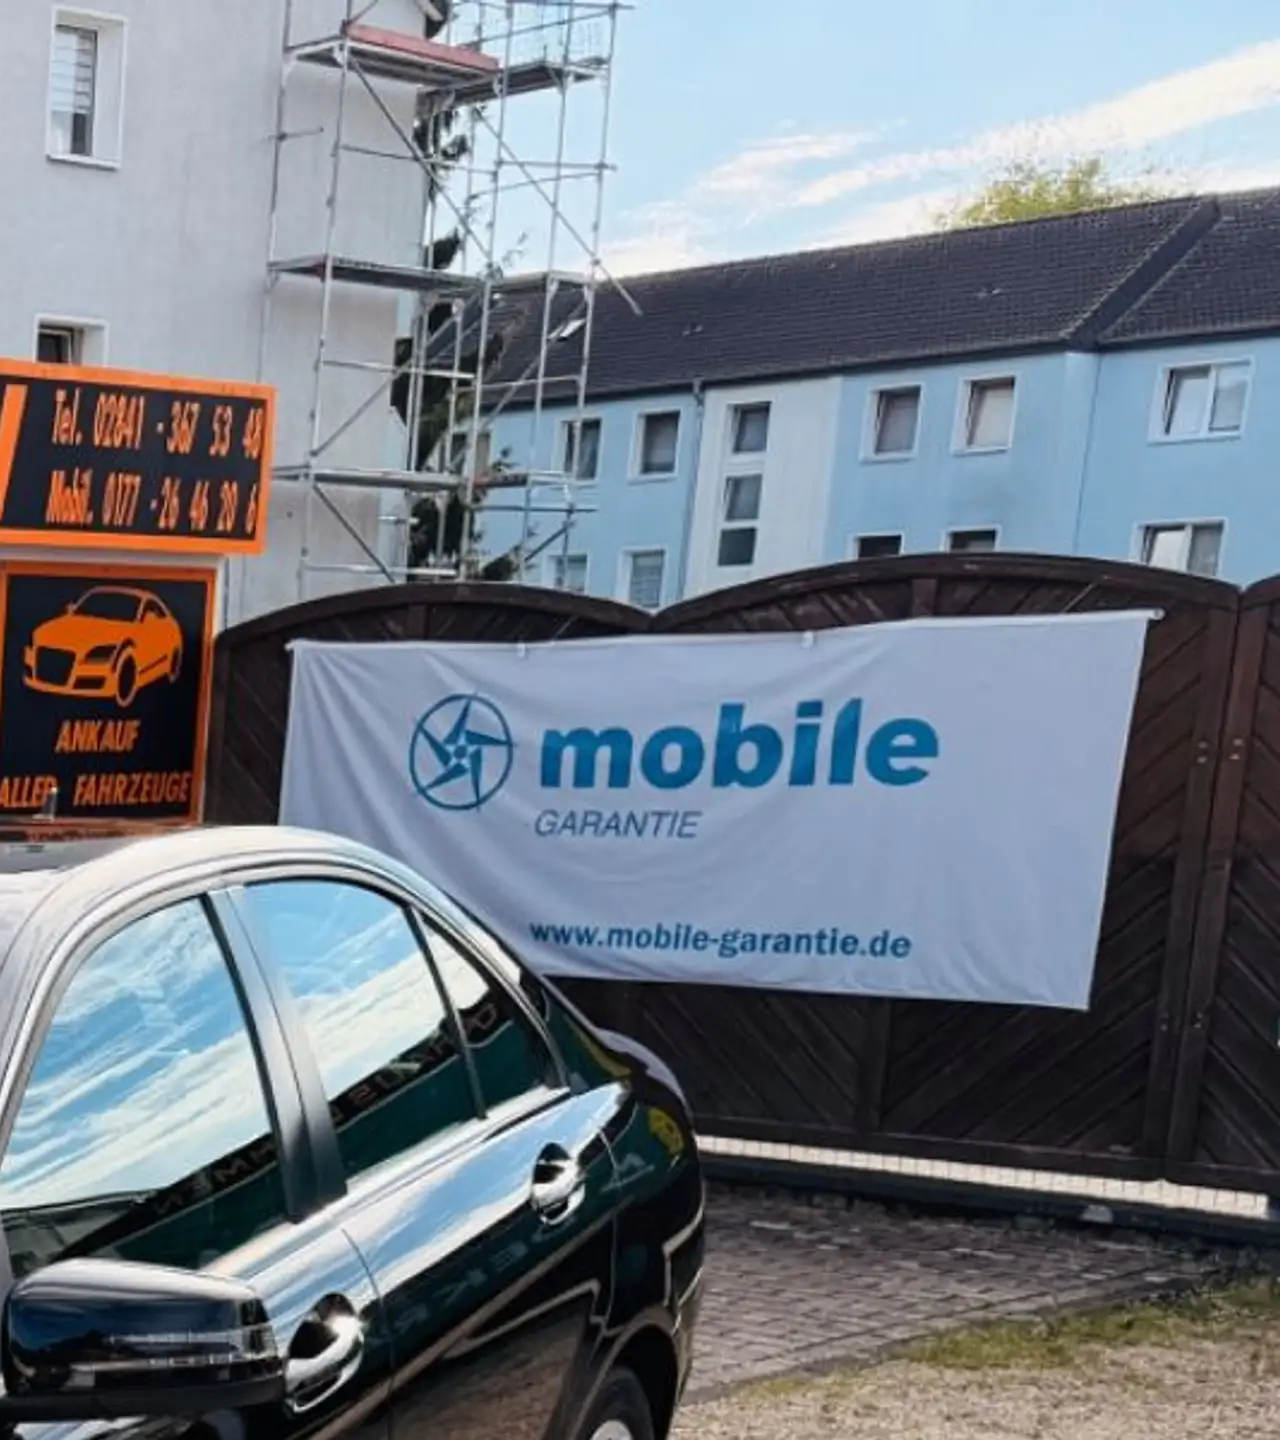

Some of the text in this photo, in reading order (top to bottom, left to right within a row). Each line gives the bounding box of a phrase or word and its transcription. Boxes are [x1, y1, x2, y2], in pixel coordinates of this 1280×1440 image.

[52, 387, 82, 445] Tel.
[93, 393, 145, 449] 02841
[209, 405, 233, 457] 53
[243, 408, 263, 459] 48
[46, 467, 94, 525] Mobil.
[102, 472, 141, 527] 0177
[190, 480, 210, 531] 46
[215, 480, 238, 532] 20
[245, 483, 258, 534] 6
[55, 719, 140, 753] ANKAUF
[538, 697, 940, 789] mobile
[73, 771, 192, 806] FAHRZEUGE
[534, 810, 702, 840] GARANTIE
[529, 917, 912, 961] www.mobile-garantie.de
